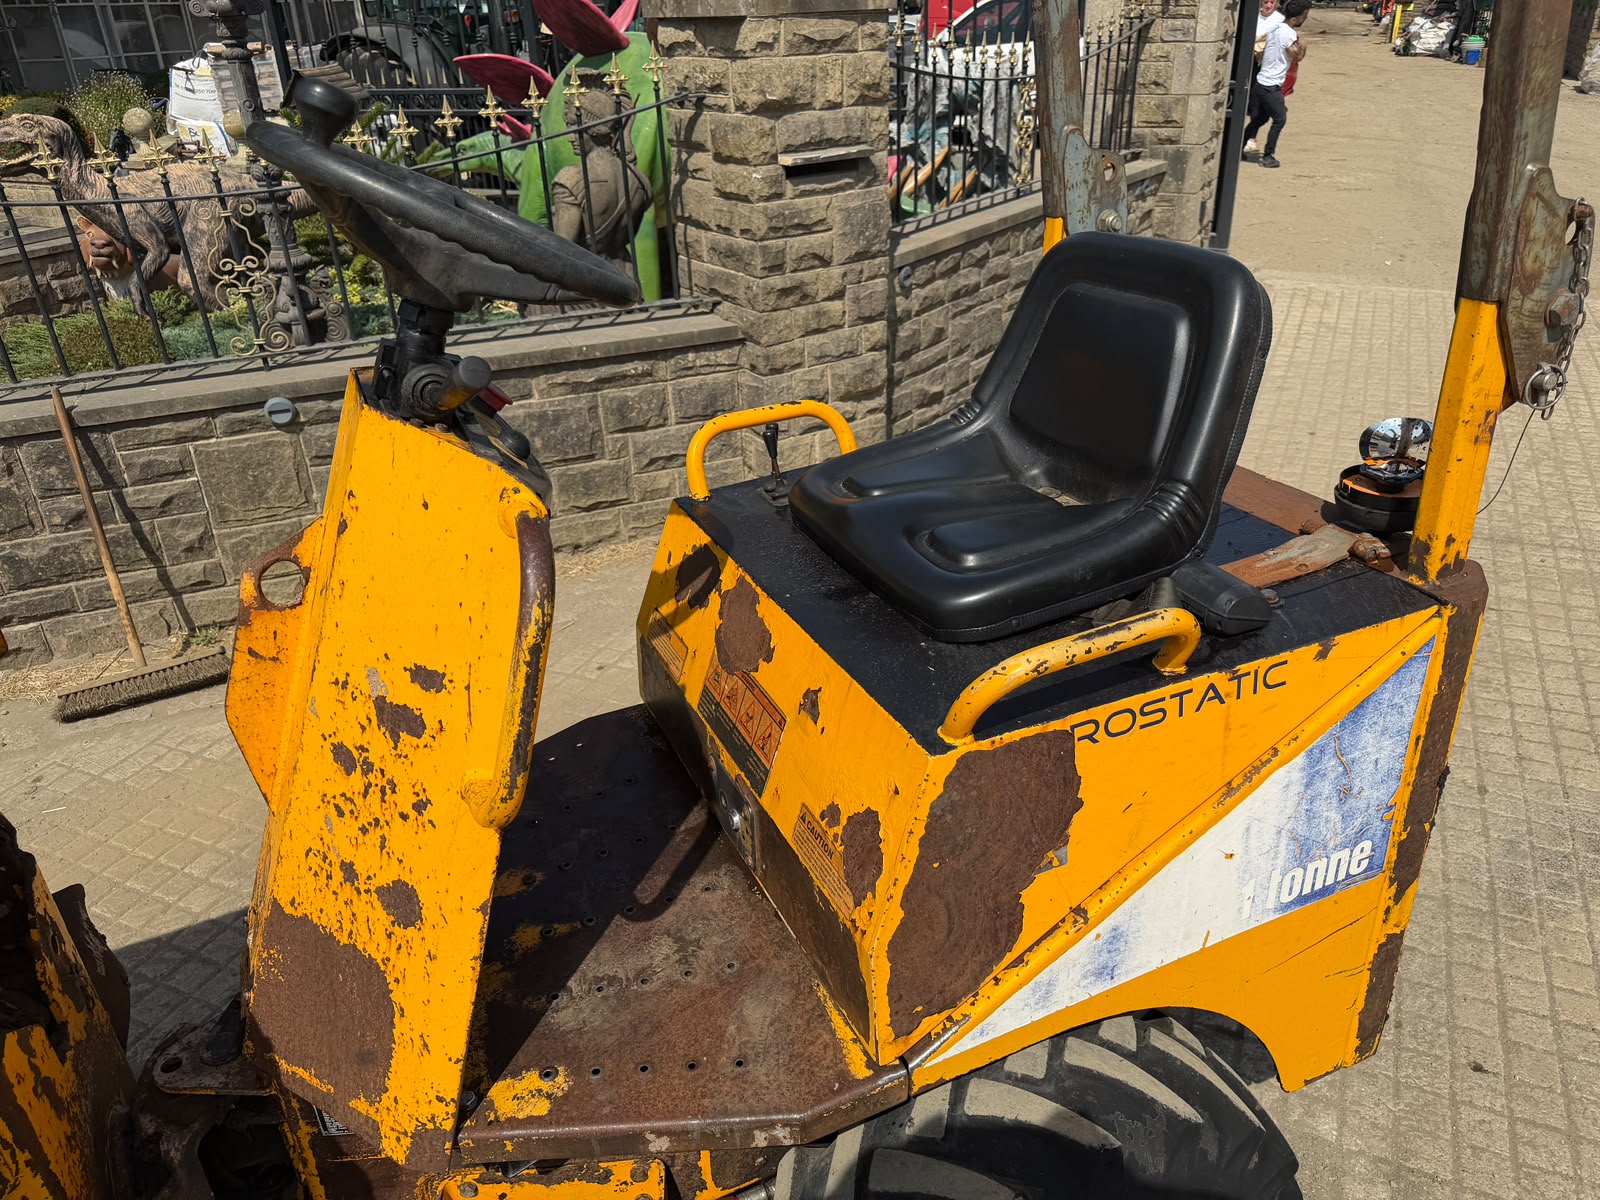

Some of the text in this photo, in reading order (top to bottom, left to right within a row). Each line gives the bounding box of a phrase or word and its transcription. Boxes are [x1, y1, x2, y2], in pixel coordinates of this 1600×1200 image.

[188, 127, 200, 137] &
[1069, 660, 1288, 744] ROSTATIC
[806, 820, 834, 860] CAUTION
[1266, 839, 1373, 909] tonne
